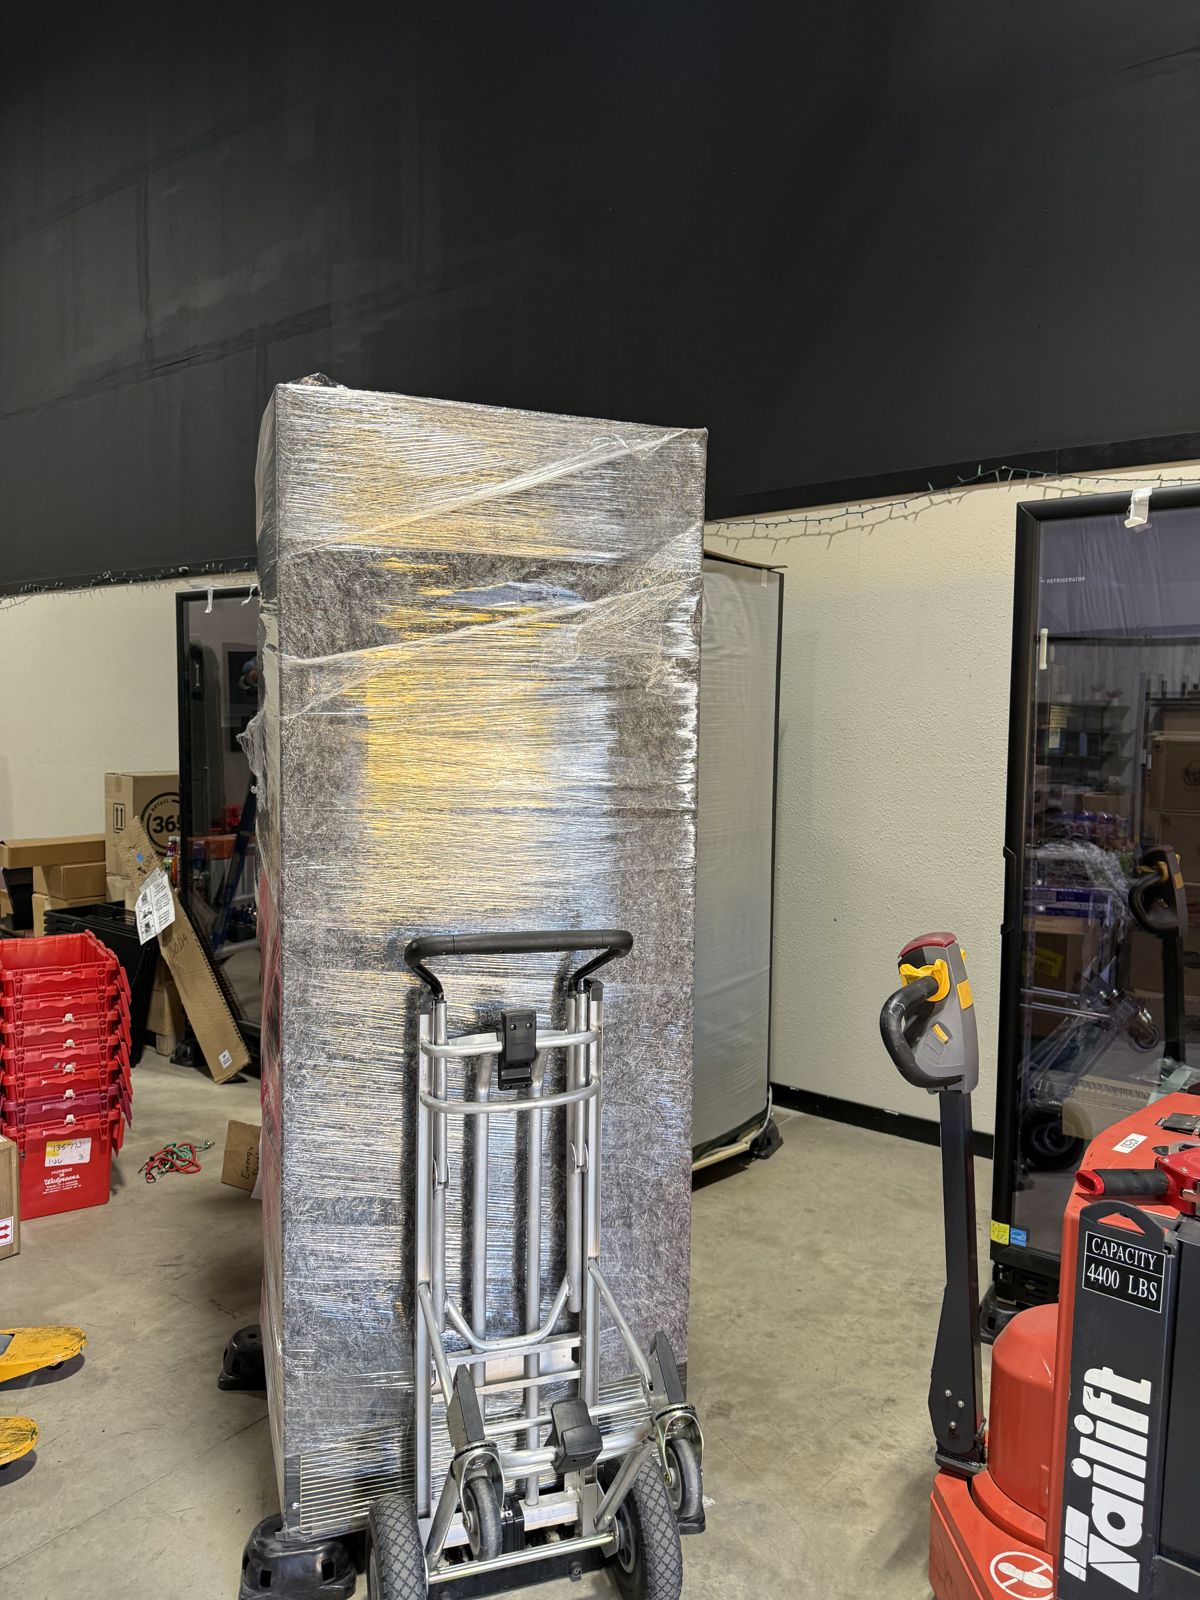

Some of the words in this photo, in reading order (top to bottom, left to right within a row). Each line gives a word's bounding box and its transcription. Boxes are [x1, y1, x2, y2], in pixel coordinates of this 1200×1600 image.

[1091, 1237, 1157, 1271] CAPACITY
[1086, 1262, 1120, 1290] 4400
[1127, 1274, 1158, 1302] LBS
